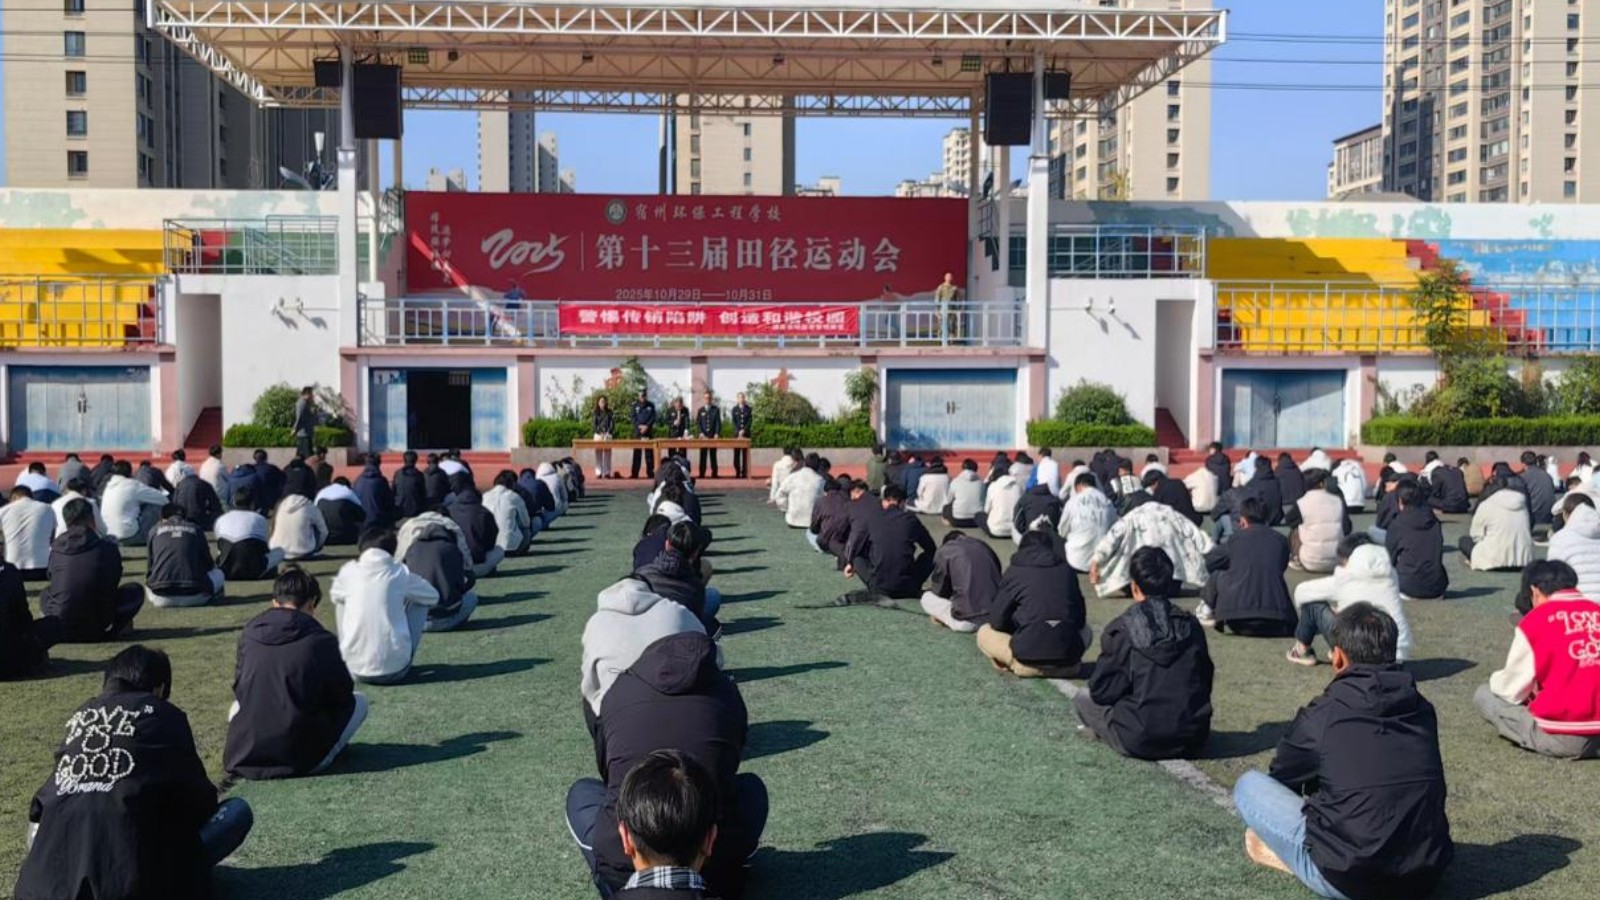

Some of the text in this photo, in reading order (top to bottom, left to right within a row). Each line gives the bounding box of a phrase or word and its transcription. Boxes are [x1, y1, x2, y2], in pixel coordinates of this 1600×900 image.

[596, 234, 901, 273] 第十三届田径运动会
[55, 747, 136, 786] GOOD
